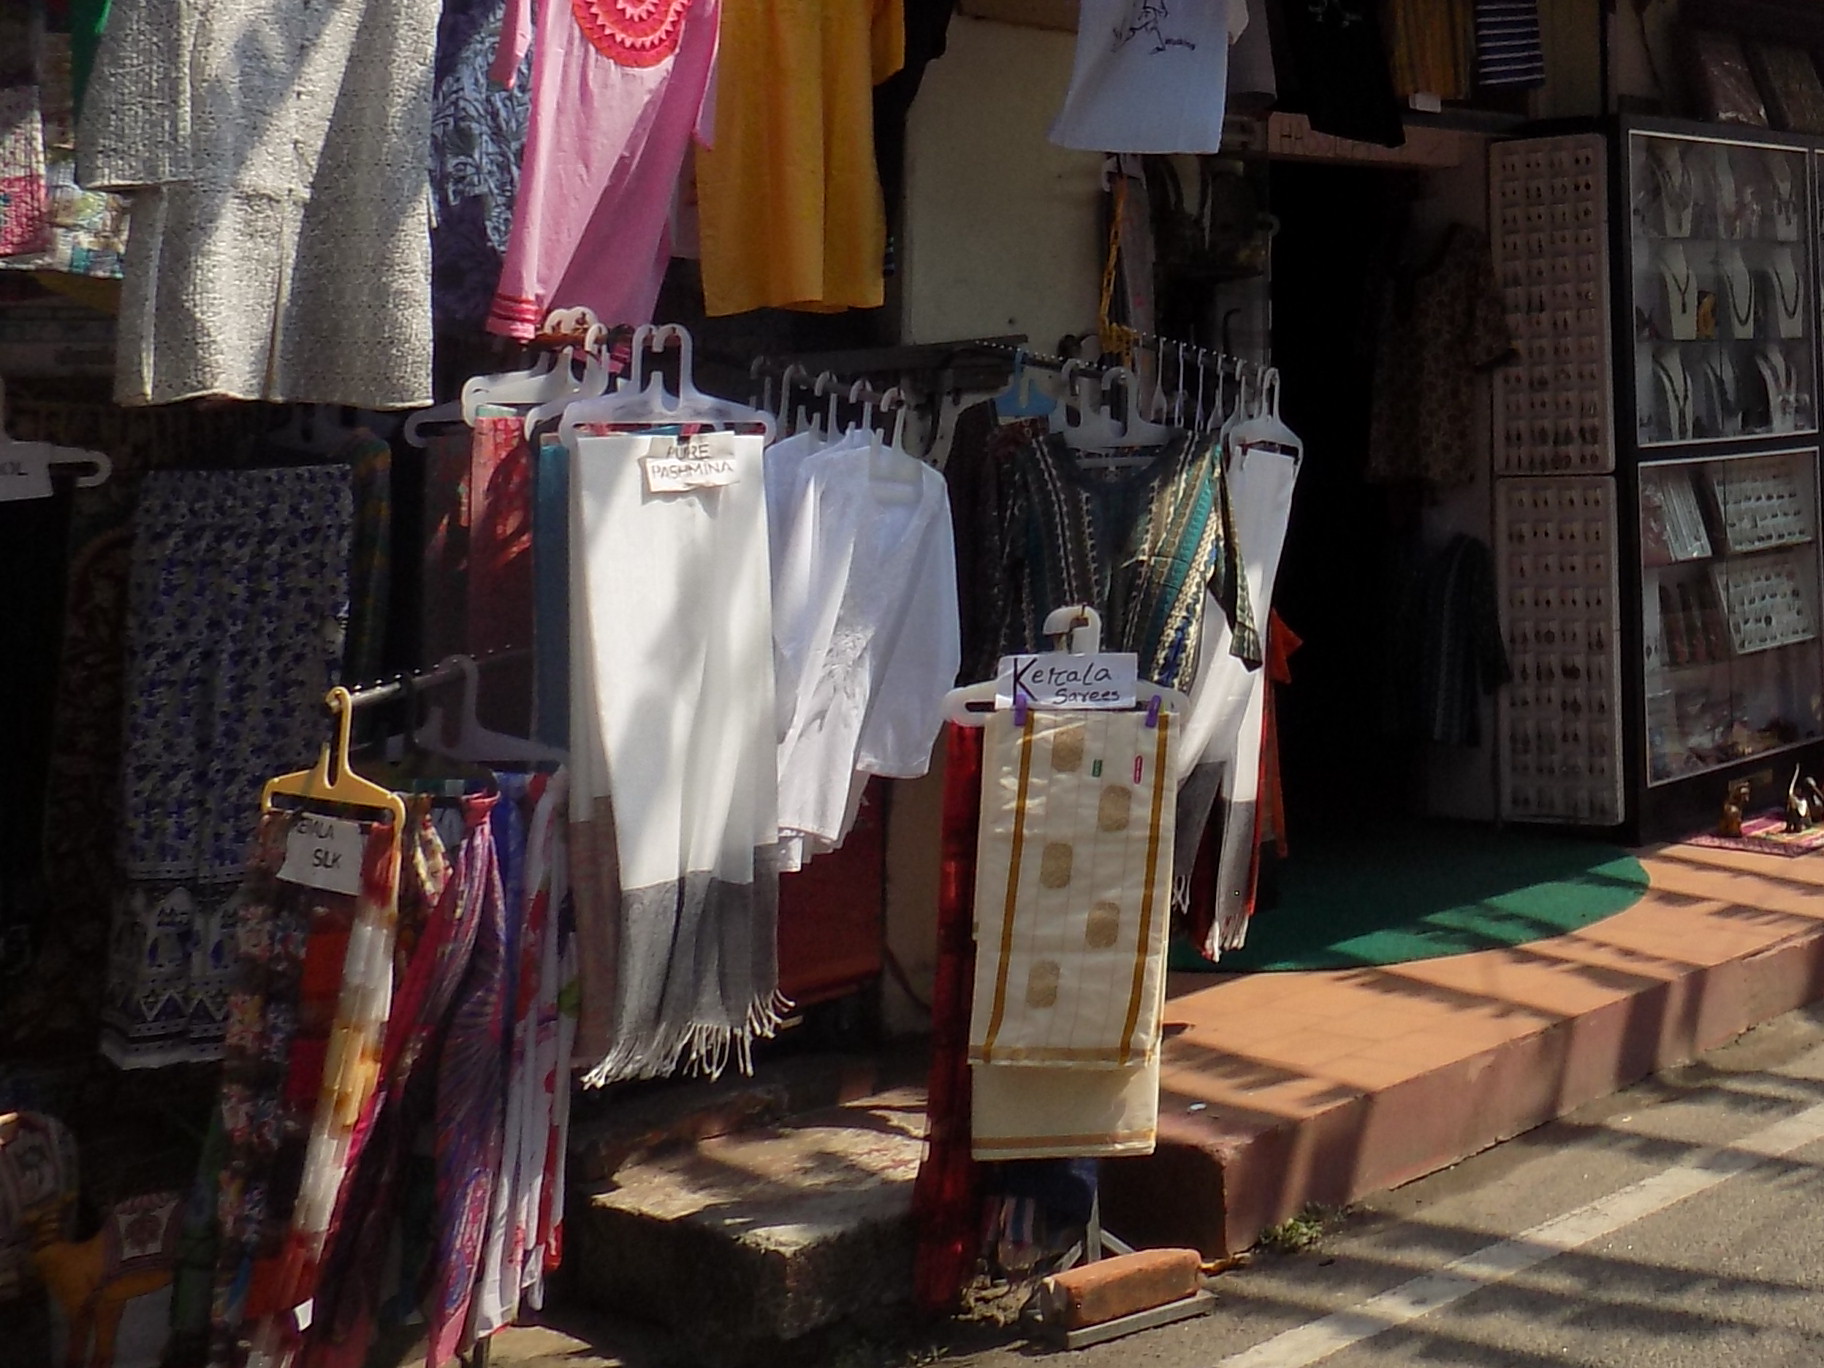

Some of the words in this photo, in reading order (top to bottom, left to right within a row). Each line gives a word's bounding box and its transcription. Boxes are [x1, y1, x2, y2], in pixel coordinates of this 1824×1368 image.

[651, 461, 734, 480] PASHMINA
[1012, 657, 1112, 706] Kerala
[1052, 687, 1121, 705] Sarees
